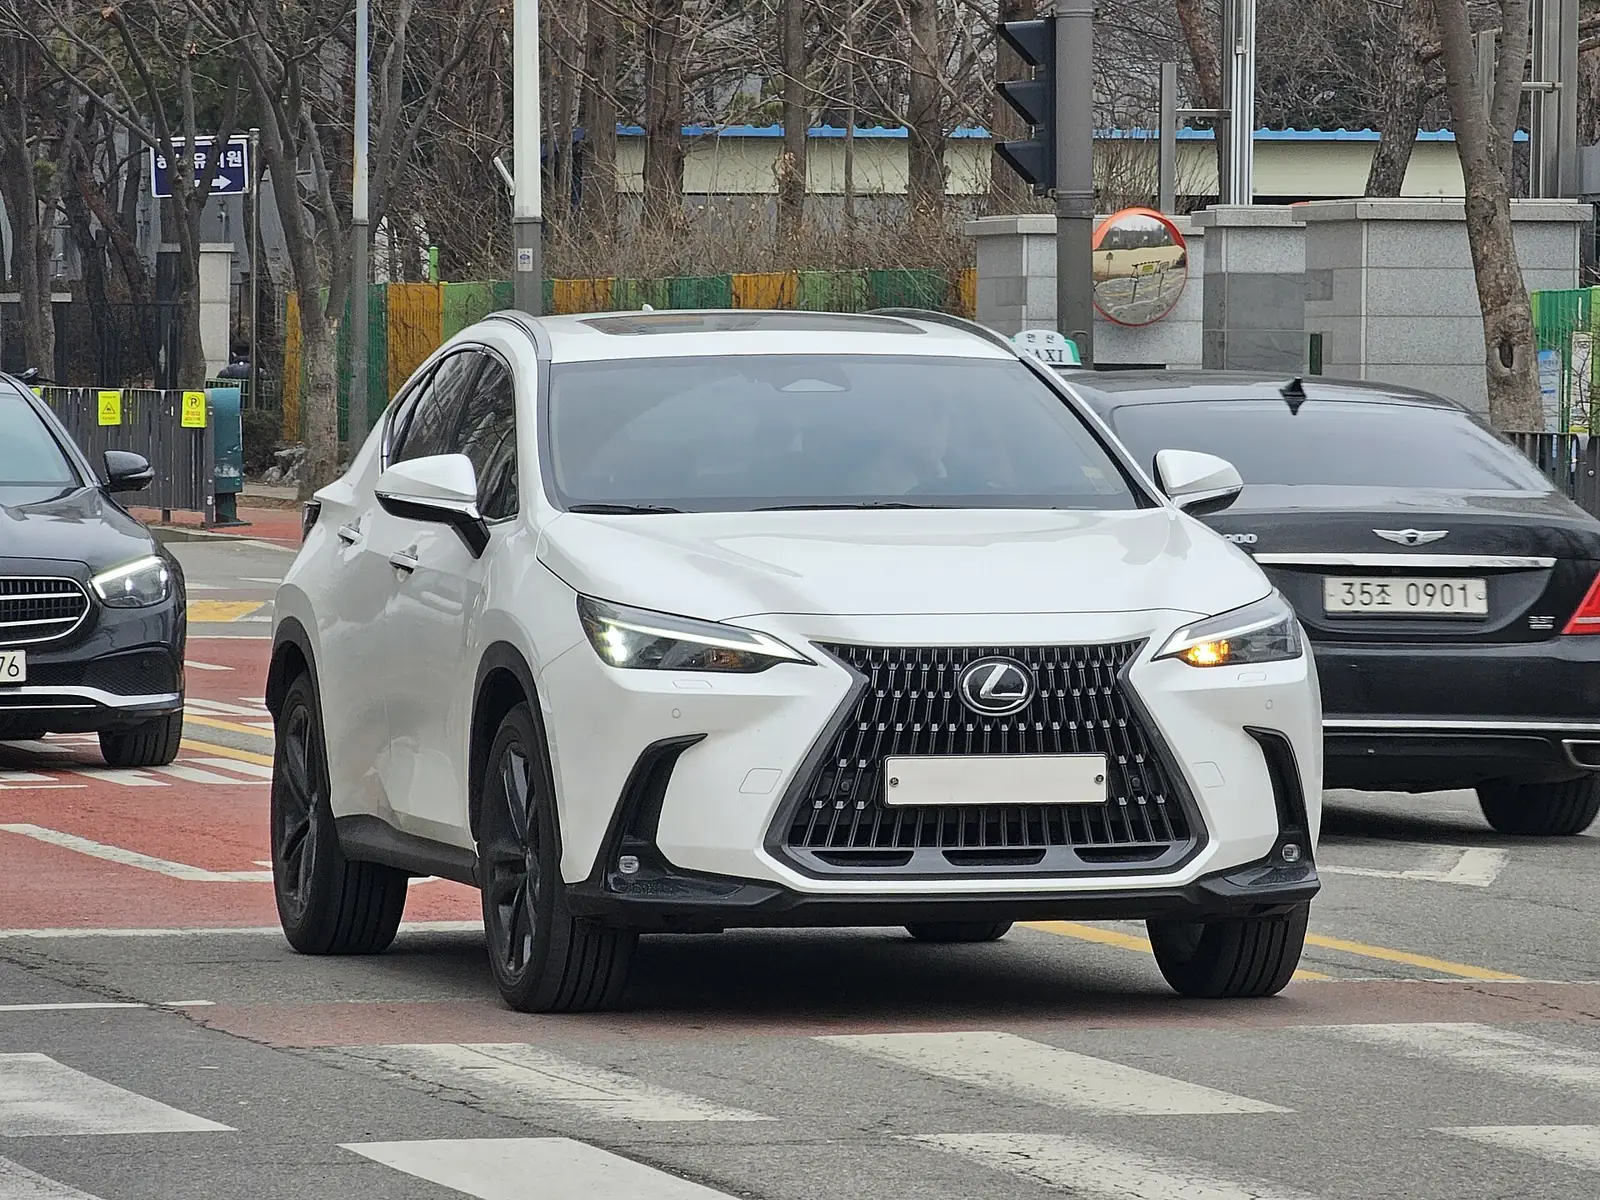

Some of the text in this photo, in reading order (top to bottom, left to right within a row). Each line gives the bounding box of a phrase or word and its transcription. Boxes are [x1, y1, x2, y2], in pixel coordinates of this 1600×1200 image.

[1024, 348, 1064, 362] AXI
[1341, 582, 1468, 608] 35조 0901
